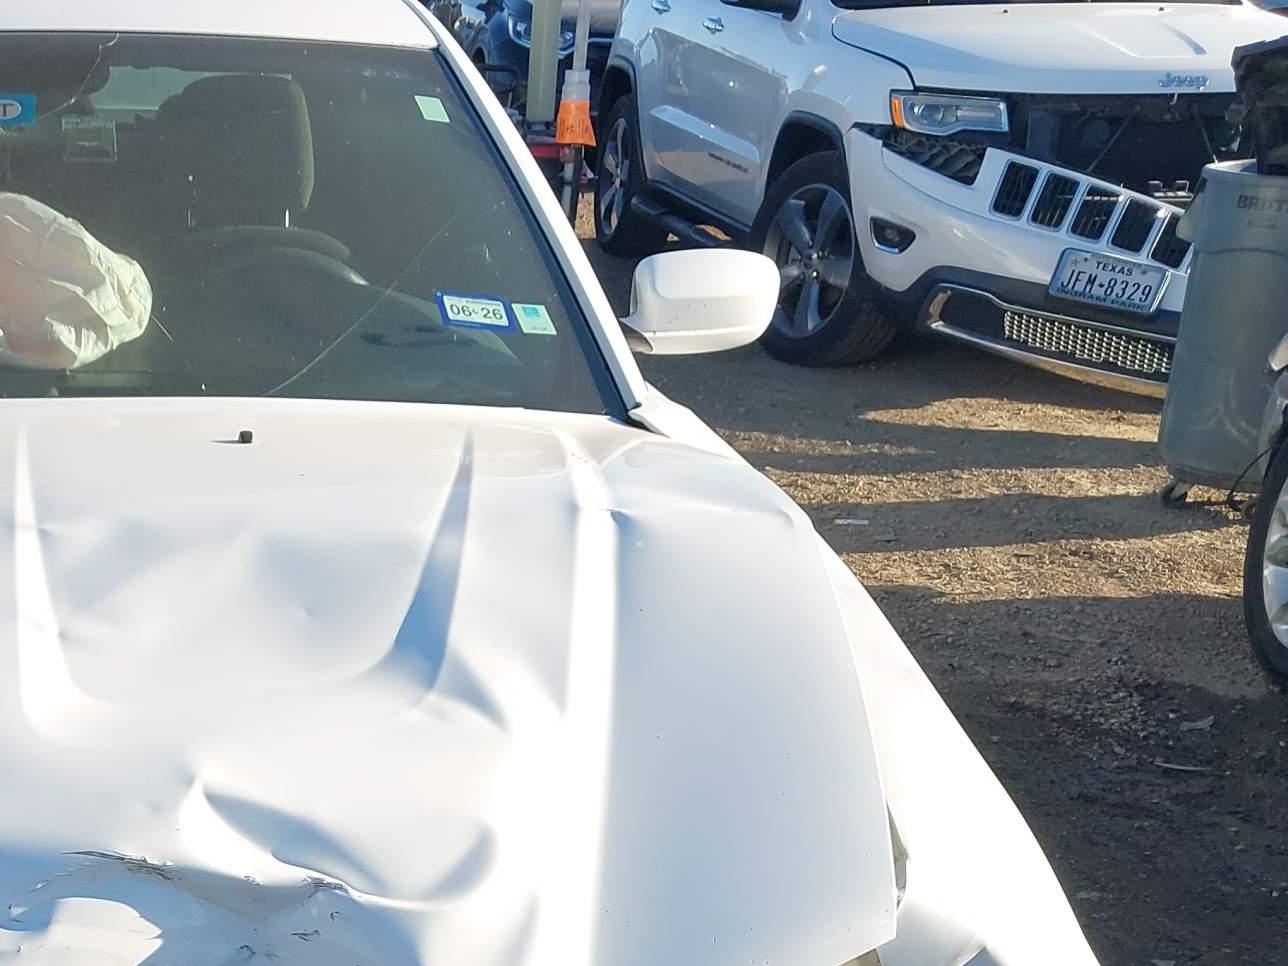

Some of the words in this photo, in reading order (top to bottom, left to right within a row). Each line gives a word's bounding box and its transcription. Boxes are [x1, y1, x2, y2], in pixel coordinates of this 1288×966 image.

[1158, 72, 1210, 91] Jeep
[1095, 261, 1133, 276] TEXAS
[1111, 299, 1148, 312] PARK
